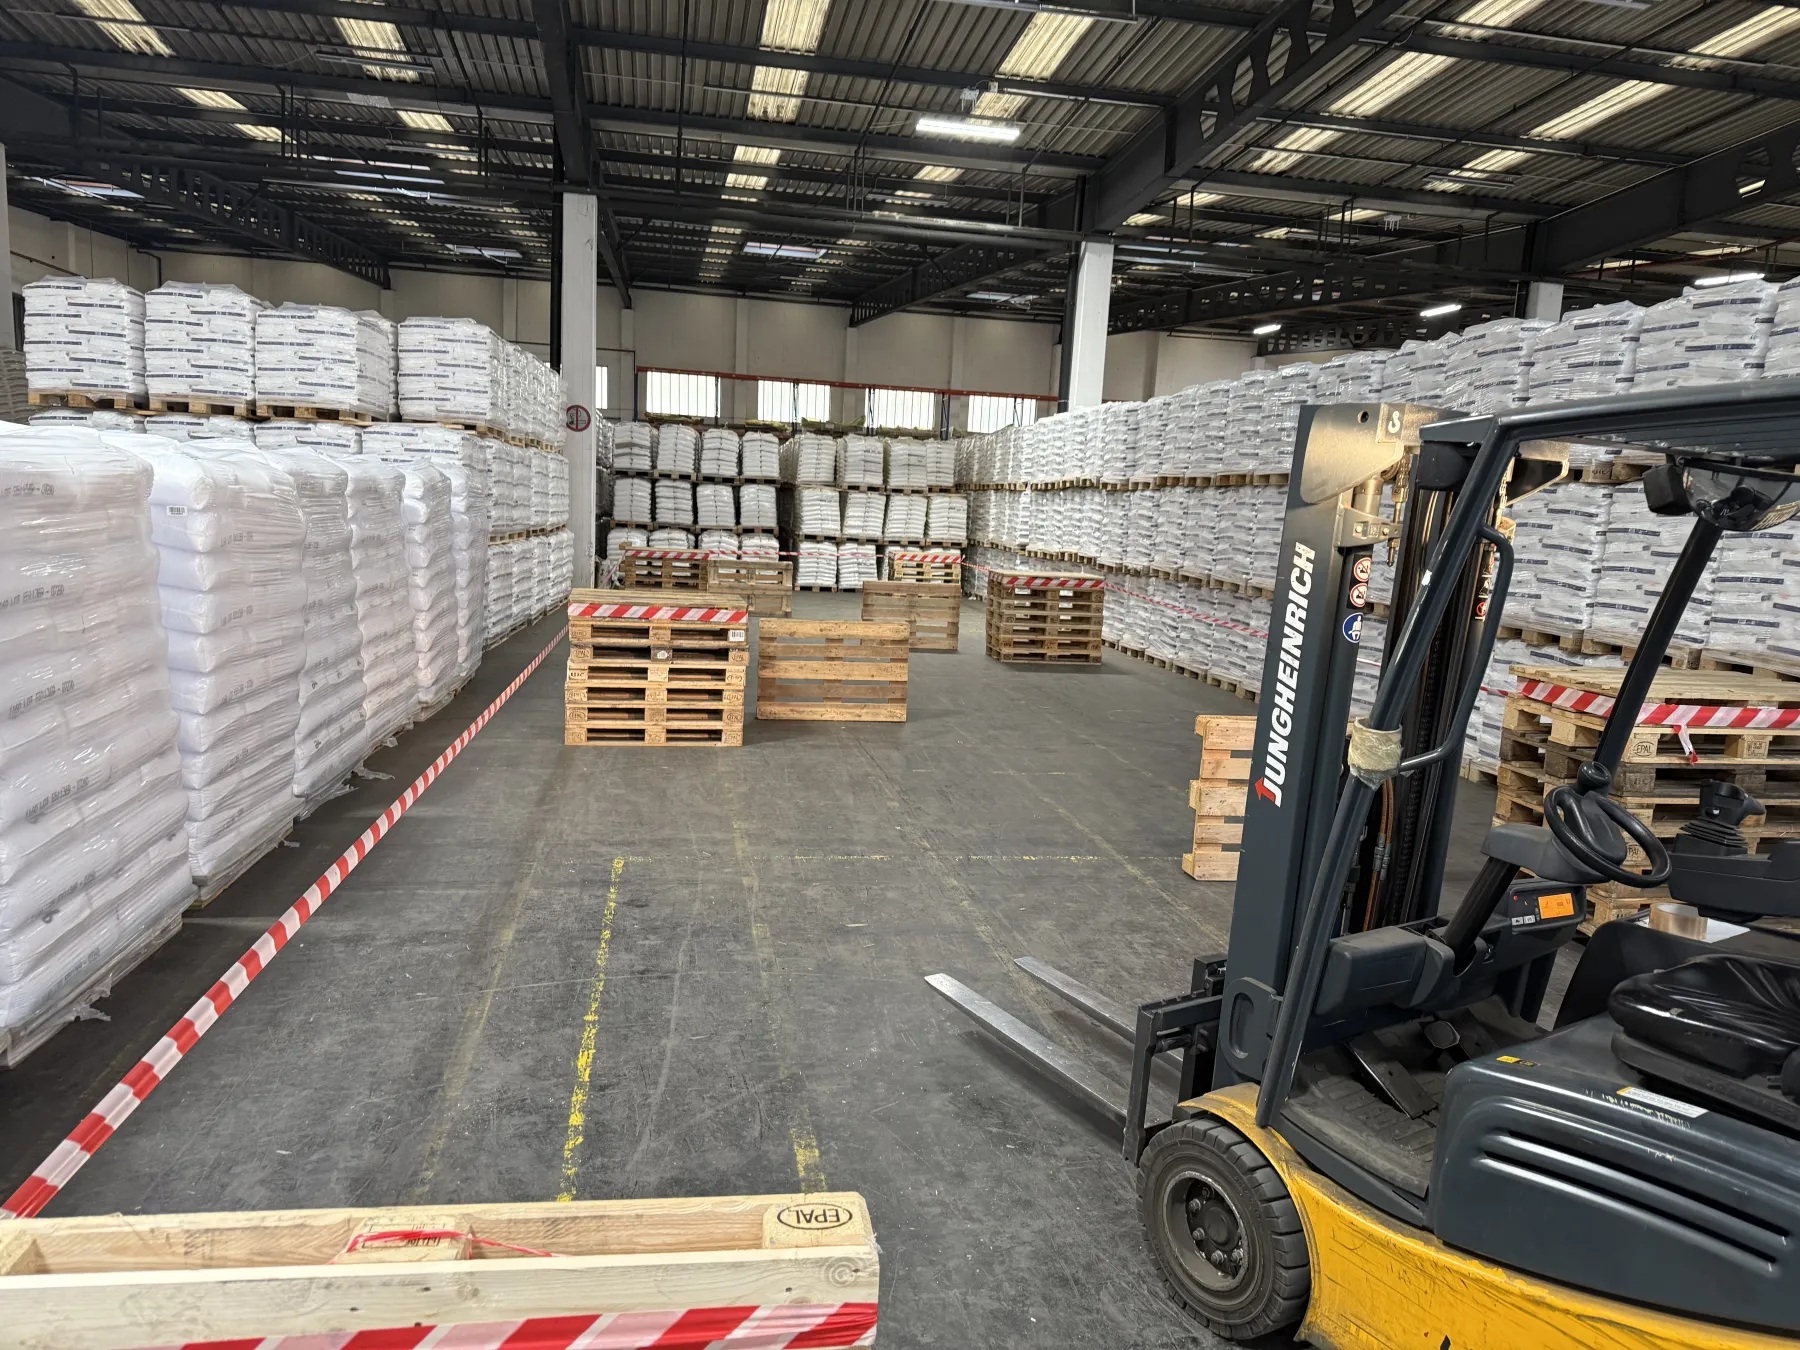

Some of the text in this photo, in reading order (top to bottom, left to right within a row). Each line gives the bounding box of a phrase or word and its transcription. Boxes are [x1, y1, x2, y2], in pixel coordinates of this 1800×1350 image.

[1255, 542, 1316, 808] JUNGHEINRICH
[1636, 744, 1652, 754] EPAL
[788, 1208, 841, 1224] EPAL
